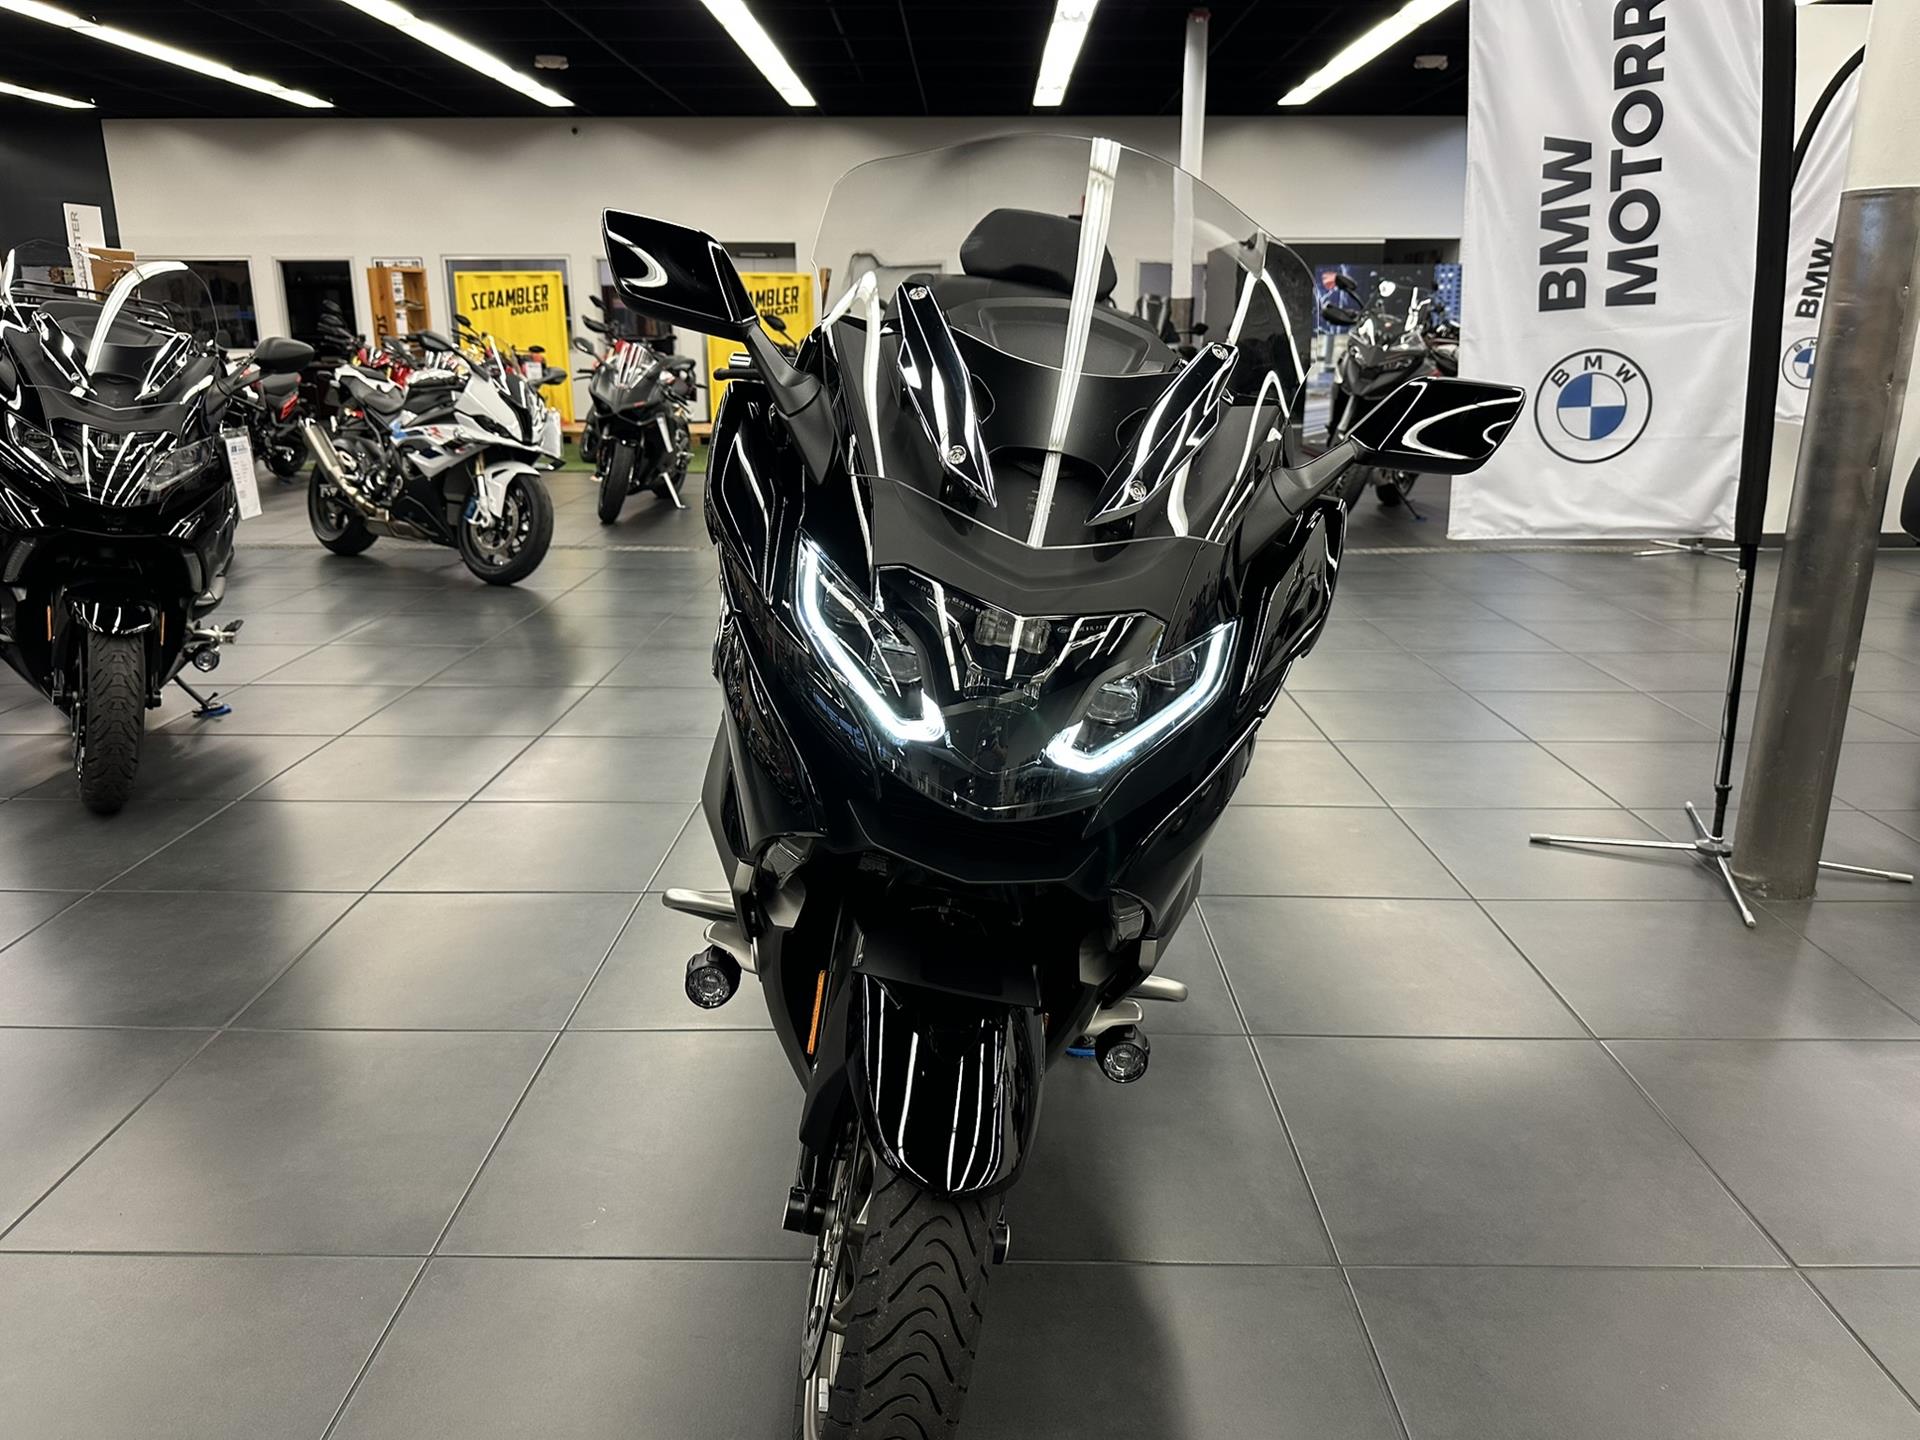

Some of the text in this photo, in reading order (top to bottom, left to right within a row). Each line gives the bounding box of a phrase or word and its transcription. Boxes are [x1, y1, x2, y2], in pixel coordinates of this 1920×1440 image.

[1605, 0, 1666, 307] MOTORR
[1538, 136, 1592, 312] BMW
[1795, 237, 1833, 318] BMW
[471, 284, 548, 311] SCRAMBLER
[510, 303, 548, 316] DUCATI
[760, 305, 798, 316] DUCATI
[1550, 355, 1637, 388] BMW
